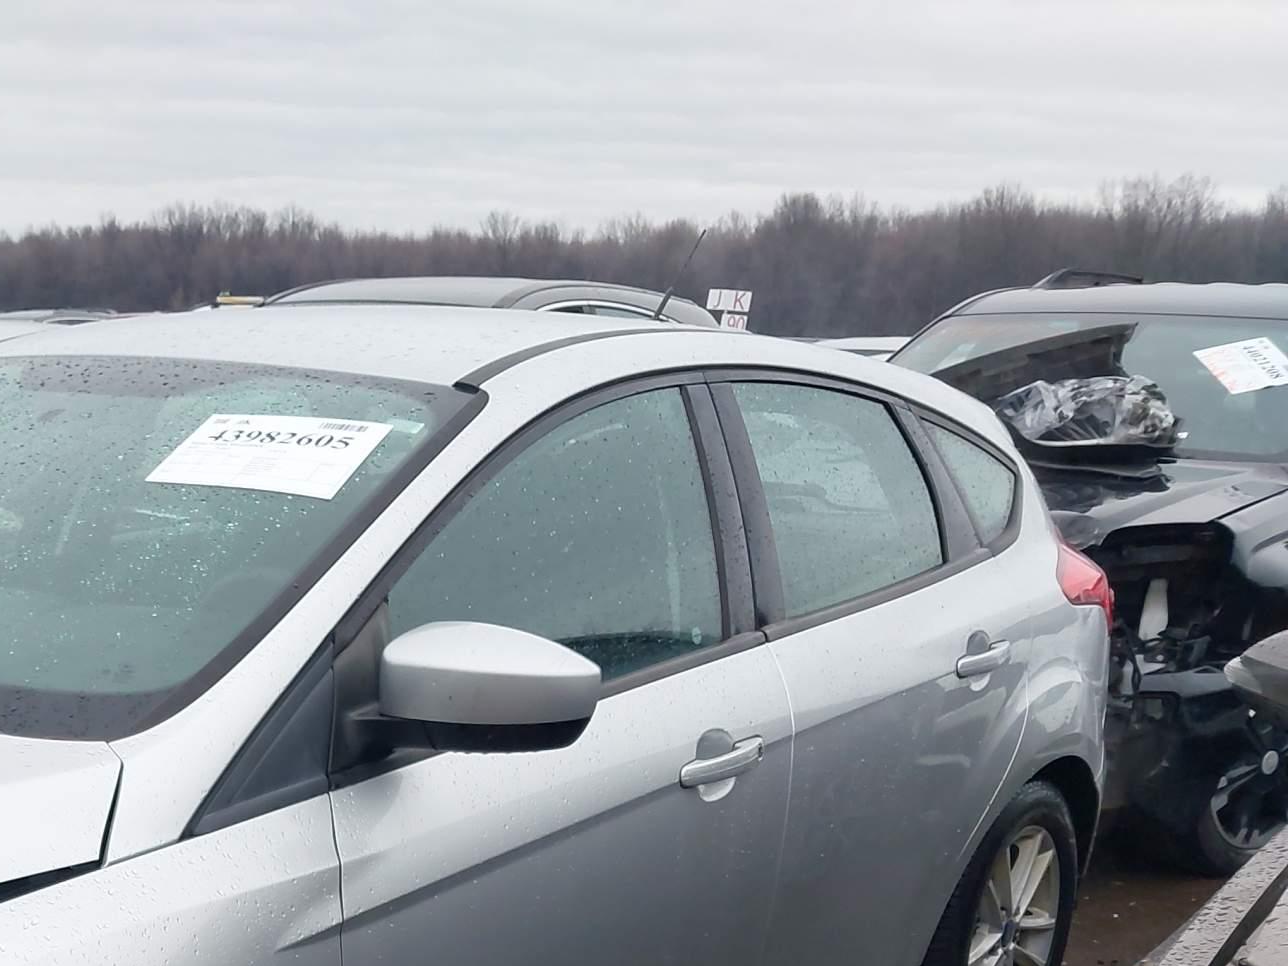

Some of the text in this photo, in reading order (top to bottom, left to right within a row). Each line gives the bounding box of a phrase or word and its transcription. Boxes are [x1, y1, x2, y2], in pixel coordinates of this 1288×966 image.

[713, 291, 746, 310] J K
[207, 429, 355, 450] 43982605
